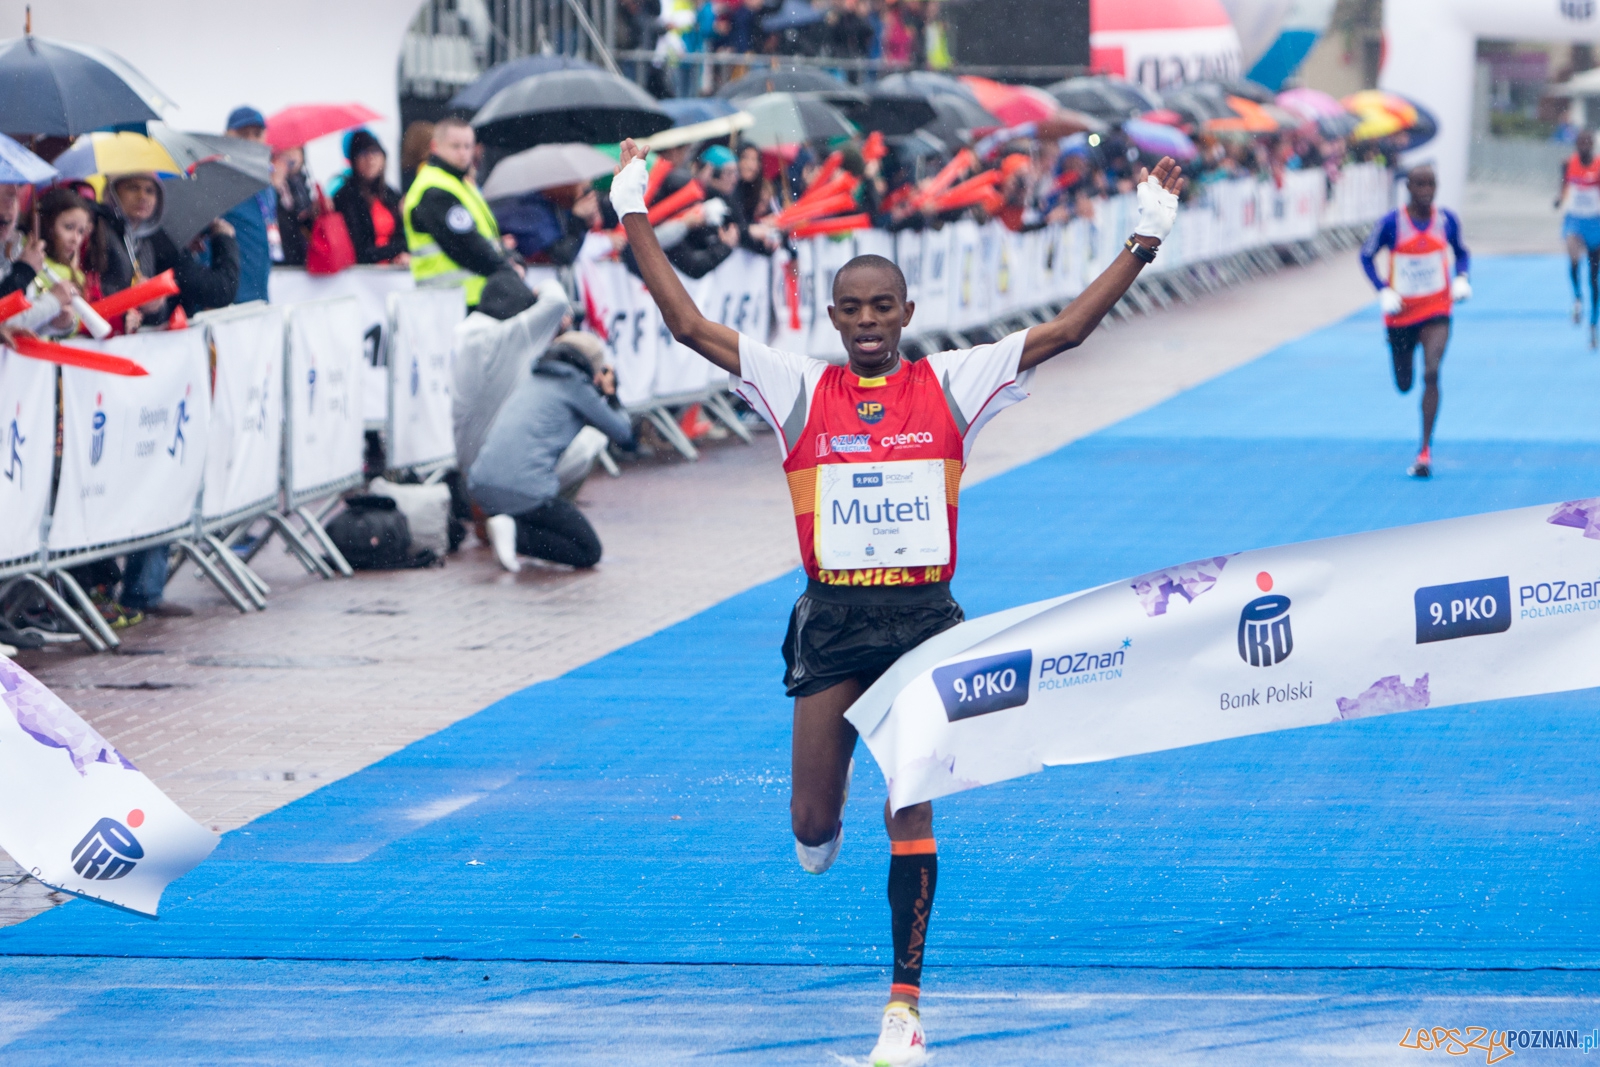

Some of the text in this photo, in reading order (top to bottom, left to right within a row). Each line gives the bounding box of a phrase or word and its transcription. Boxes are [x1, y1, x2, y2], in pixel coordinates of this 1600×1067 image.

[857, 403, 882, 415] JP
[881, 432, 933, 448] cuenca
[833, 495, 930, 525] Muteti
[873, 527, 900, 536] Daniel
[818, 567, 915, 586] DANIEL
[1038, 669, 1123, 692] PÓŁMARATON
[1220, 681, 1313, 711] Bank Polski
